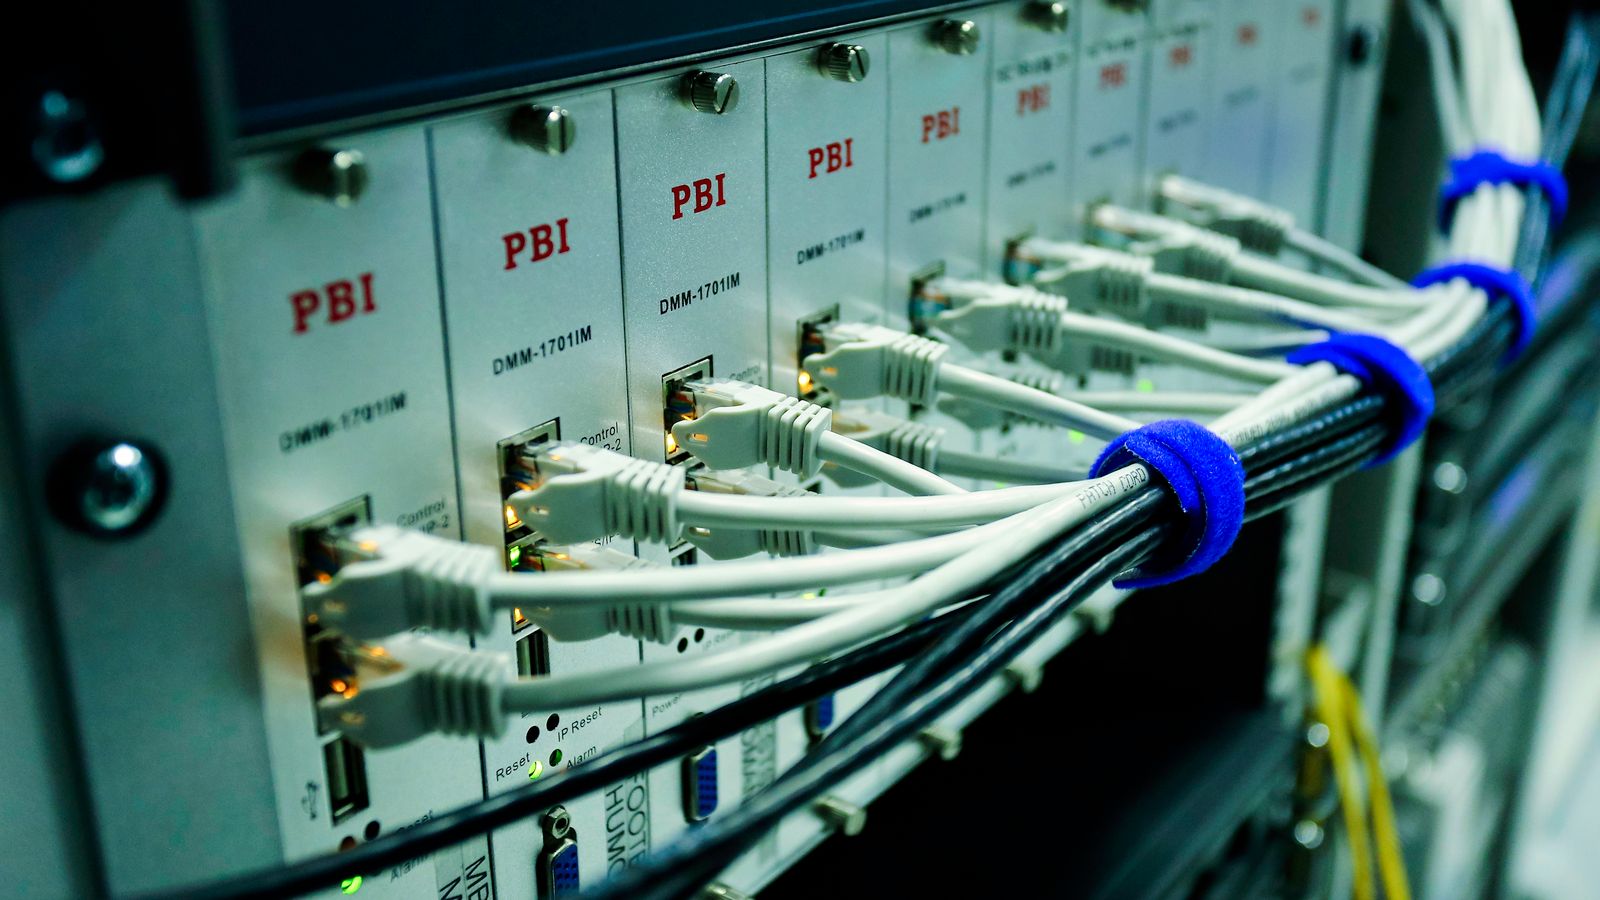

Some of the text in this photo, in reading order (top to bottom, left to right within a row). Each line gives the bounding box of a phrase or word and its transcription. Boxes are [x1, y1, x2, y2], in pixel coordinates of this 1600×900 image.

[921, 106, 961, 144] PBI
[808, 138, 854, 179] PBI
[671, 172, 727, 221] PBI
[502, 217, 571, 271] PBI
[289, 272, 378, 336] PBI
[660, 272, 740, 315] DMM-1701IM
[493, 325, 592, 376] DMM-1701IM
[280, 391, 406, 453] DMM-1701IM
[1119, 467, 1147, 492] CORD
[557, 706, 602, 743] IP Reset
[496, 752, 530, 782] Reset
[566, 745, 598, 770] Alarm
